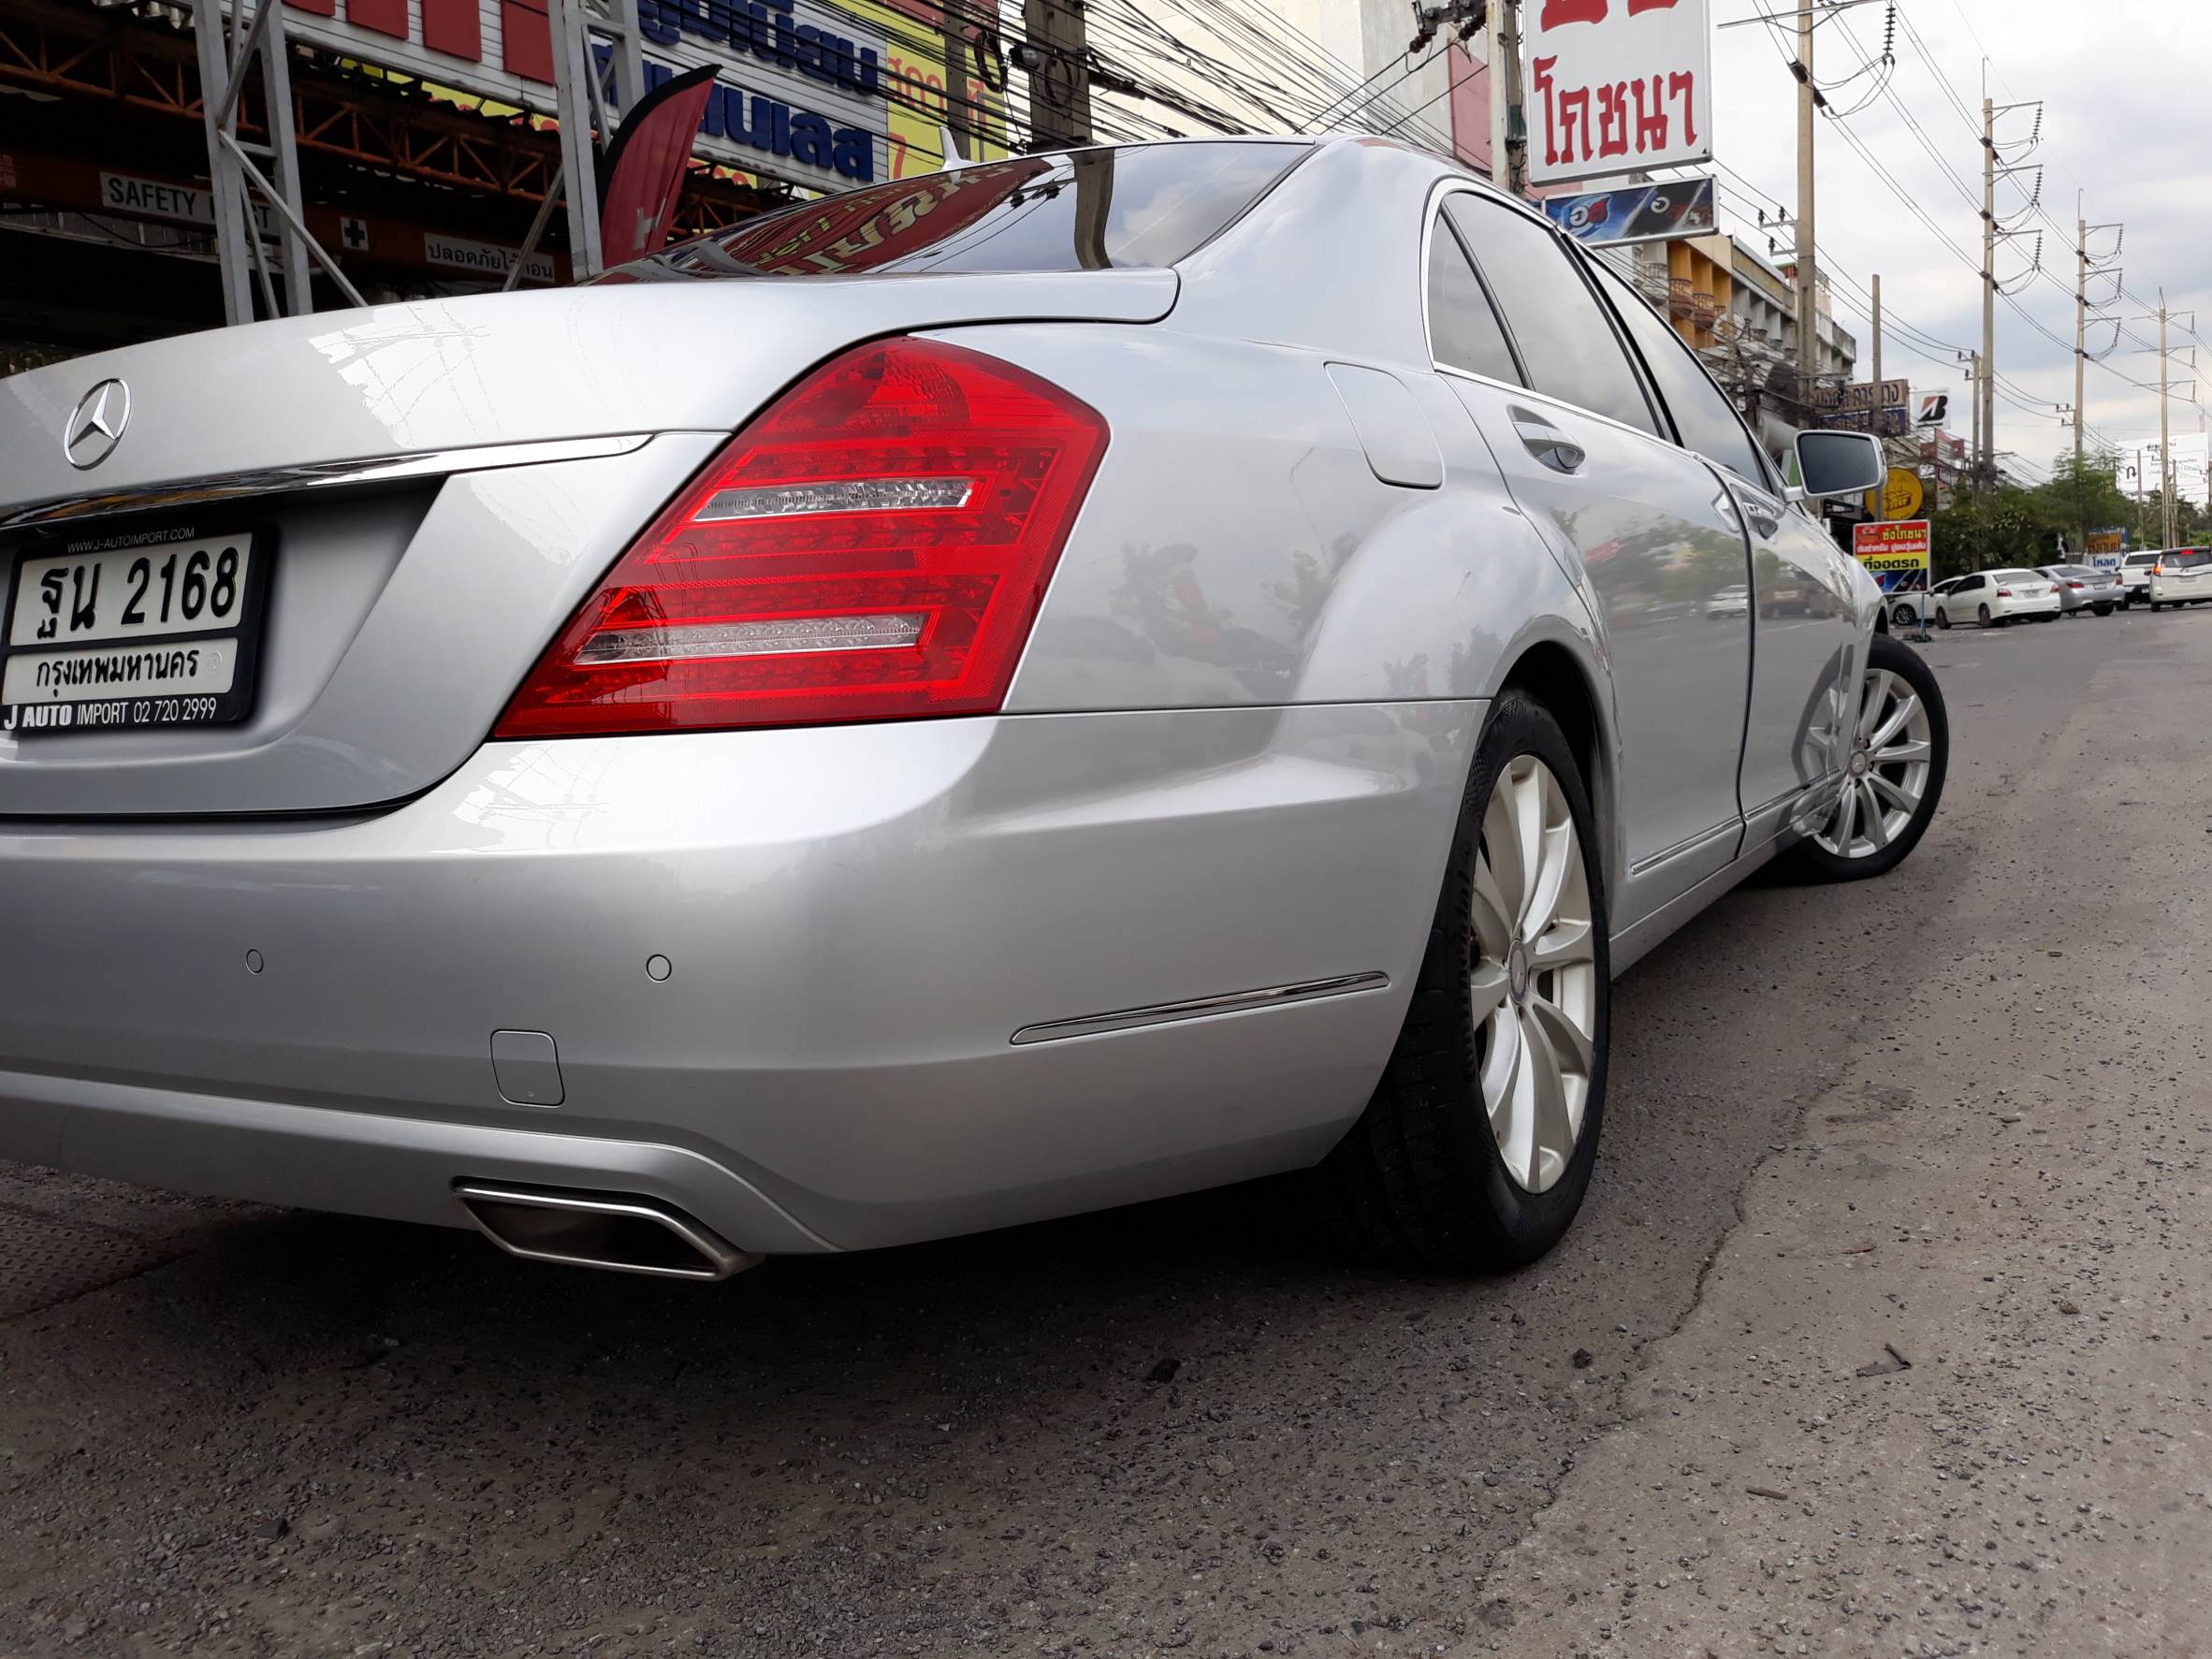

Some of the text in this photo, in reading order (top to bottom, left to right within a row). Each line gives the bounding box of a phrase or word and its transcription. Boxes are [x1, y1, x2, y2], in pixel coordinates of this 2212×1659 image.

[1533, 54, 1697, 167] โภชนา
[109, 177, 197, 216] SAFETY
[67, 527, 196, 553] WWW.J-AUTOIMPORT.COM
[1863, 556, 1920, 570] ที่จอดรถ
[37, 546, 240, 640] ฐน 2168
[36, 649, 200, 697] กรุงเทพมหานคร
[4, 697, 217, 730] J AUTO IMPORT 02 720 2999
